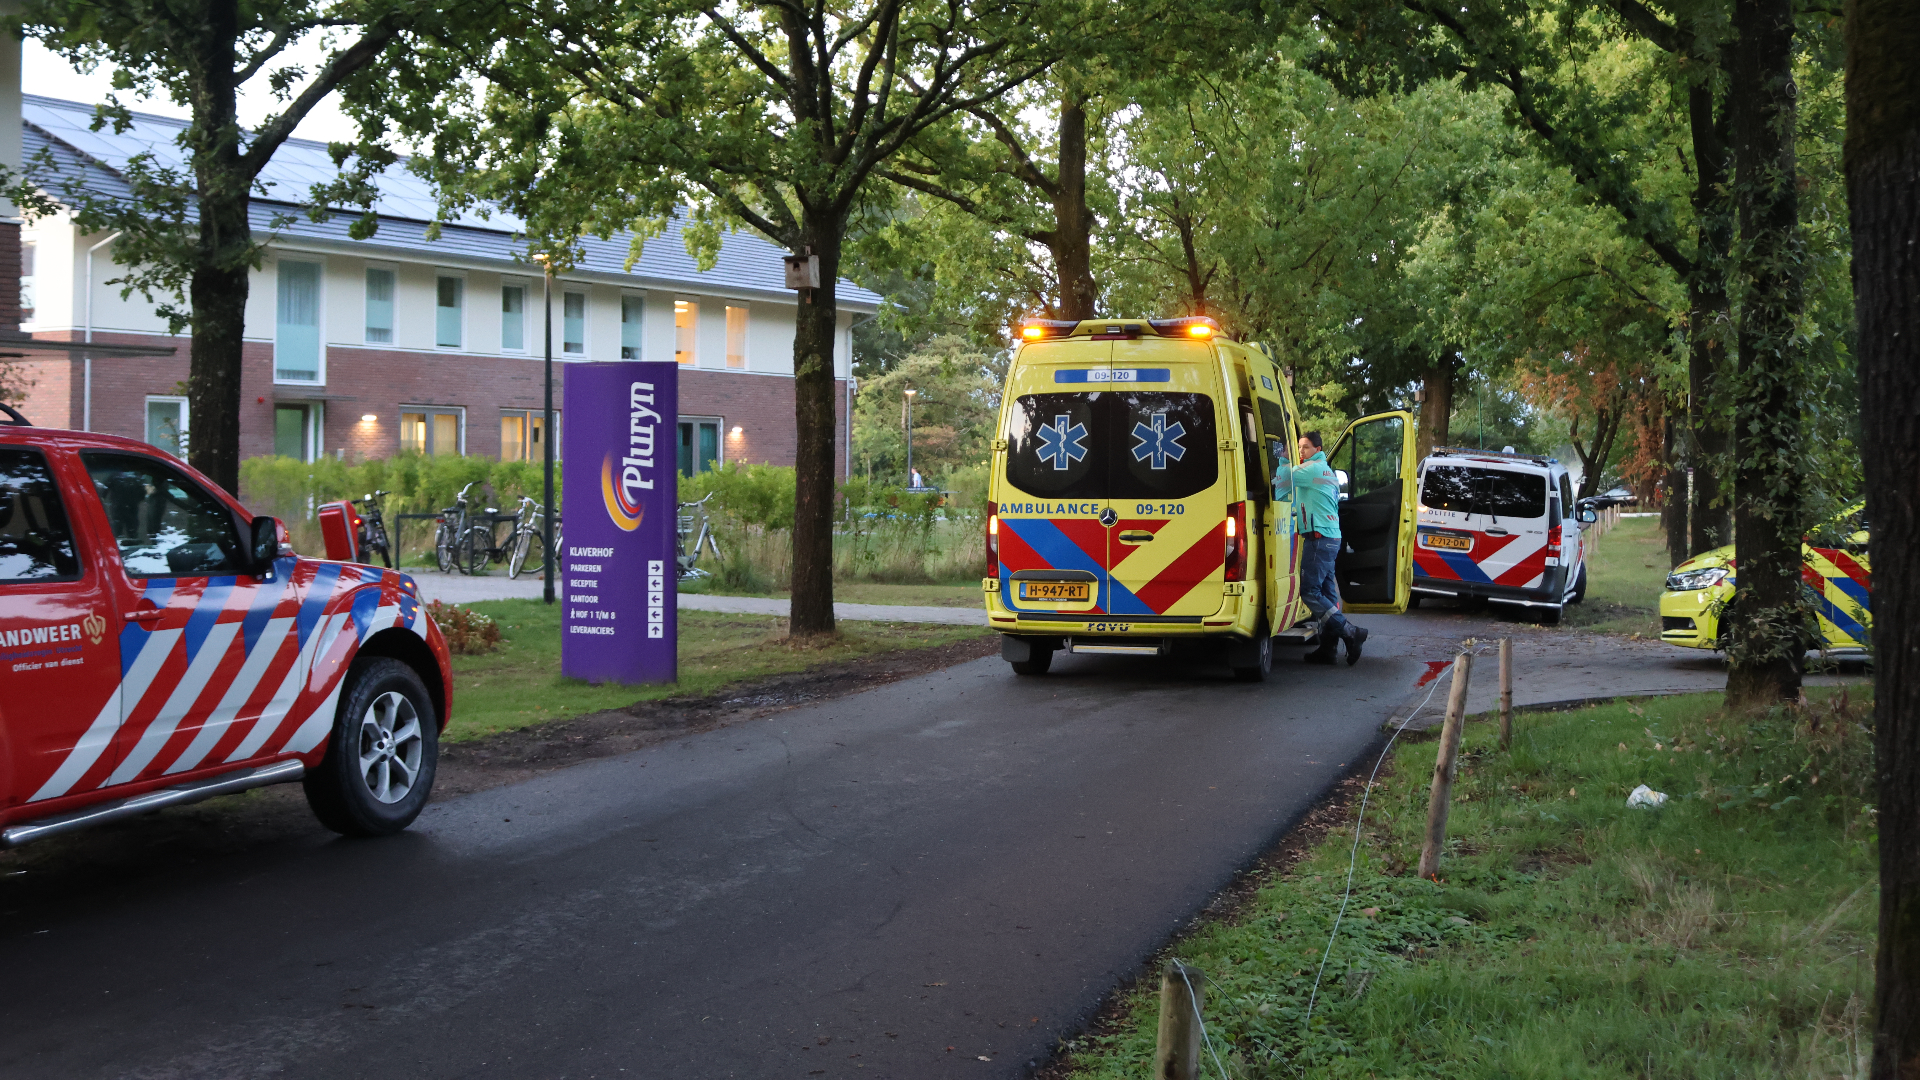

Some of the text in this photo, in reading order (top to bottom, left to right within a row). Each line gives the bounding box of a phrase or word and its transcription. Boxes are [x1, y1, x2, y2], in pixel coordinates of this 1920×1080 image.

[1094, 371, 1130, 380] 09-120
[622, 381, 661, 490] Pluryn
[1000, 503, 1099, 514] AMBULANCE
[1136, 503, 1185, 515] 09-120
[1423, 508, 1456, 518] OLITIE
[1430, 536, 1466, 547] Z-712-DN
[569, 546, 614, 557] KLAVERHOF
[570, 564, 602, 573] PARKEREN
[570, 579, 598, 588] RECEPTIE
[1030, 585, 1083, 597] H-947-RT
[570, 595, 599, 603] KANTOOR
[575, 610, 616, 620] HOF 1 T/M 8
[570, 625, 615, 635] LEVERANCIERS
[12, 657, 85, 673] Officier van dienst
